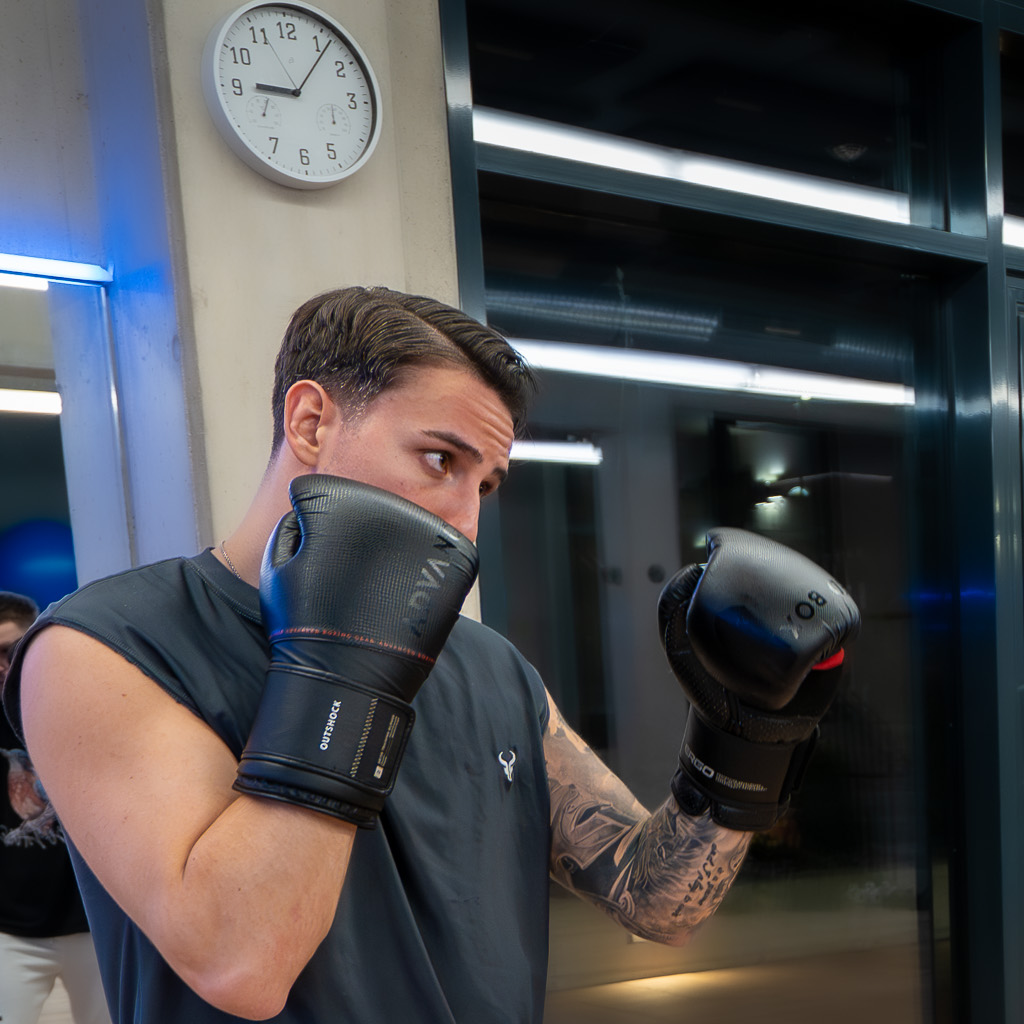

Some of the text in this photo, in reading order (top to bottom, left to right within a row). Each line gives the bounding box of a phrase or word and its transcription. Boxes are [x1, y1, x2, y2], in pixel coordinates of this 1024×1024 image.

[249, 26, 269, 45] 11
[276, 21, 297, 40] 12
[312, 35, 321, 52] 1
[230, 47, 251, 65] 10
[335, 61, 346, 78] 2
[231, 78, 243, 96] 9
[346, 93, 357, 110] 3
[268, 136, 279, 154] 7
[326, 143, 337, 160] 5
[299, 149, 310, 165] 6
[319, 700, 342, 751] OUTSHOCK
